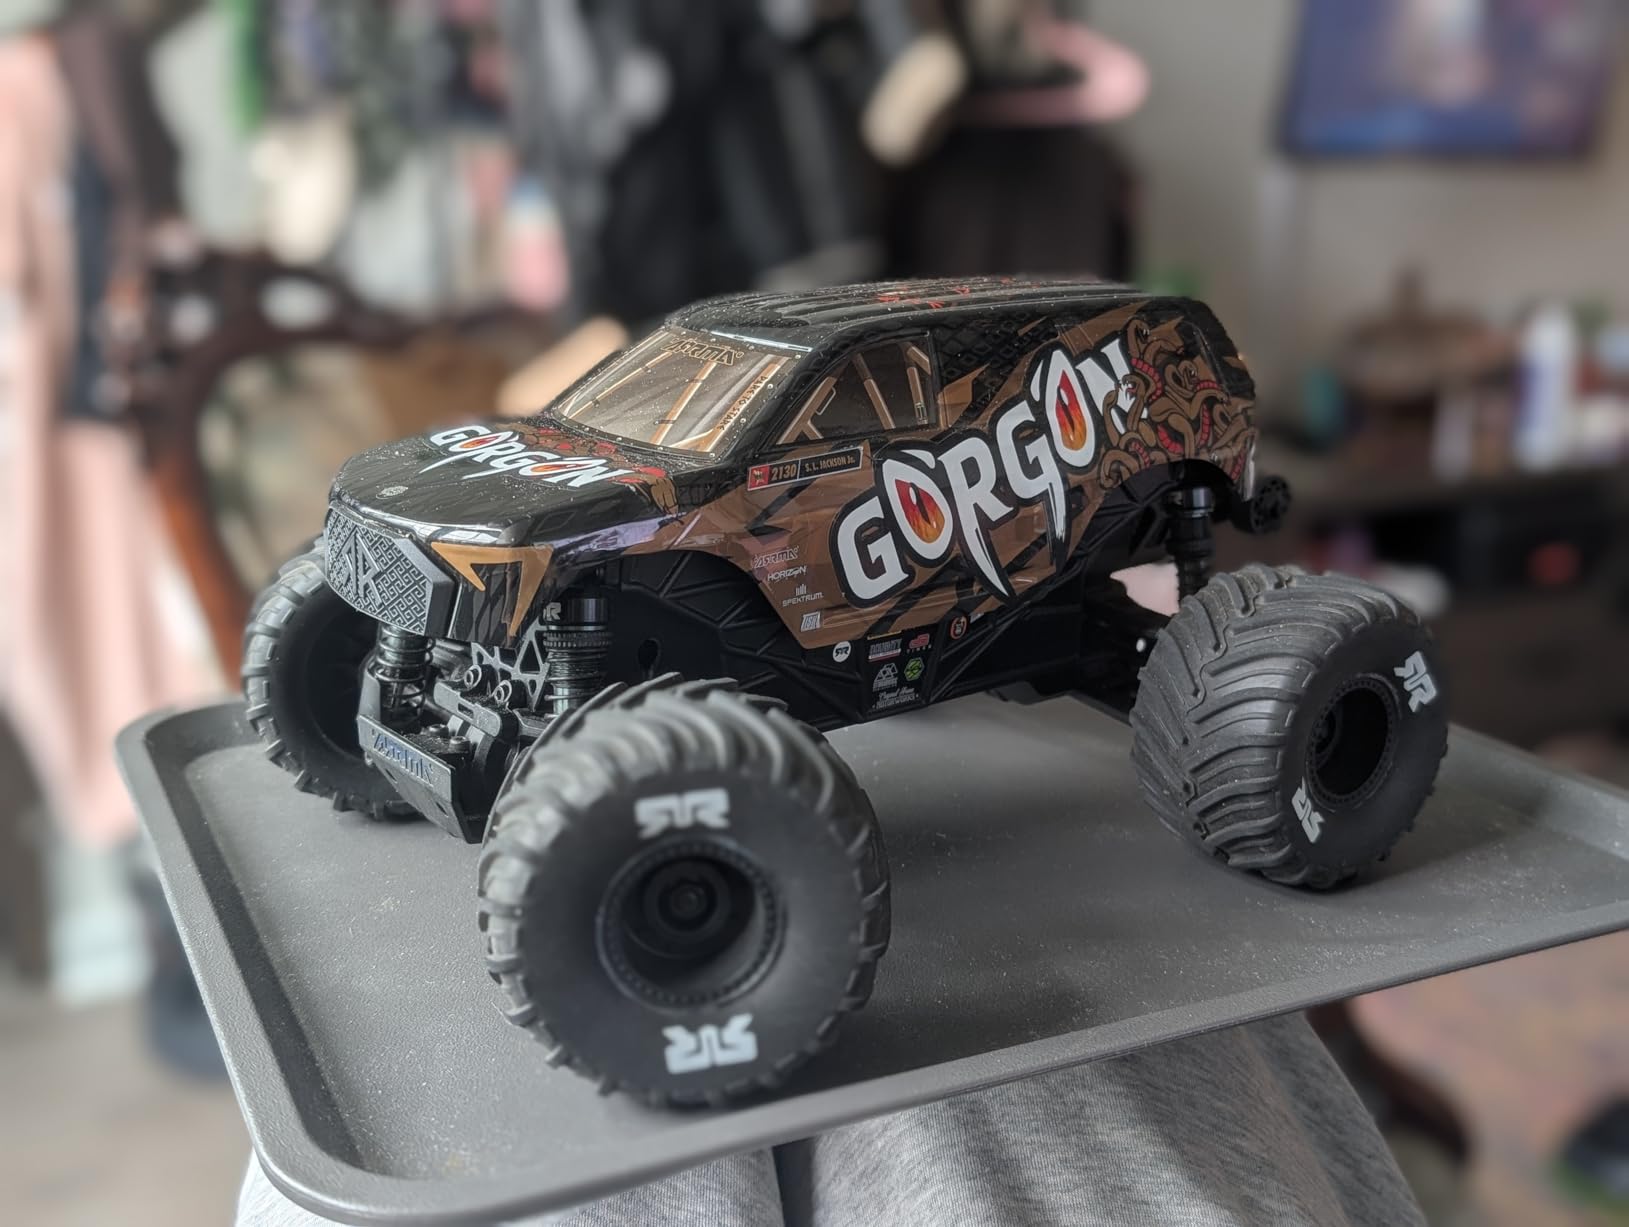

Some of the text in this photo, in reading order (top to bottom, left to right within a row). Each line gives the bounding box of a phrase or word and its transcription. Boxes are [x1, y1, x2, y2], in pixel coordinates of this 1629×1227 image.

[419, 425, 635, 488] GORGON
[838, 338, 1149, 597] GORGON
[771, 463, 797, 481] 2130
[820, 457, 847, 470] JACKSON
[767, 565, 808, 582] HORIZON
[782, 591, 824, 607] SPEKTRUM
